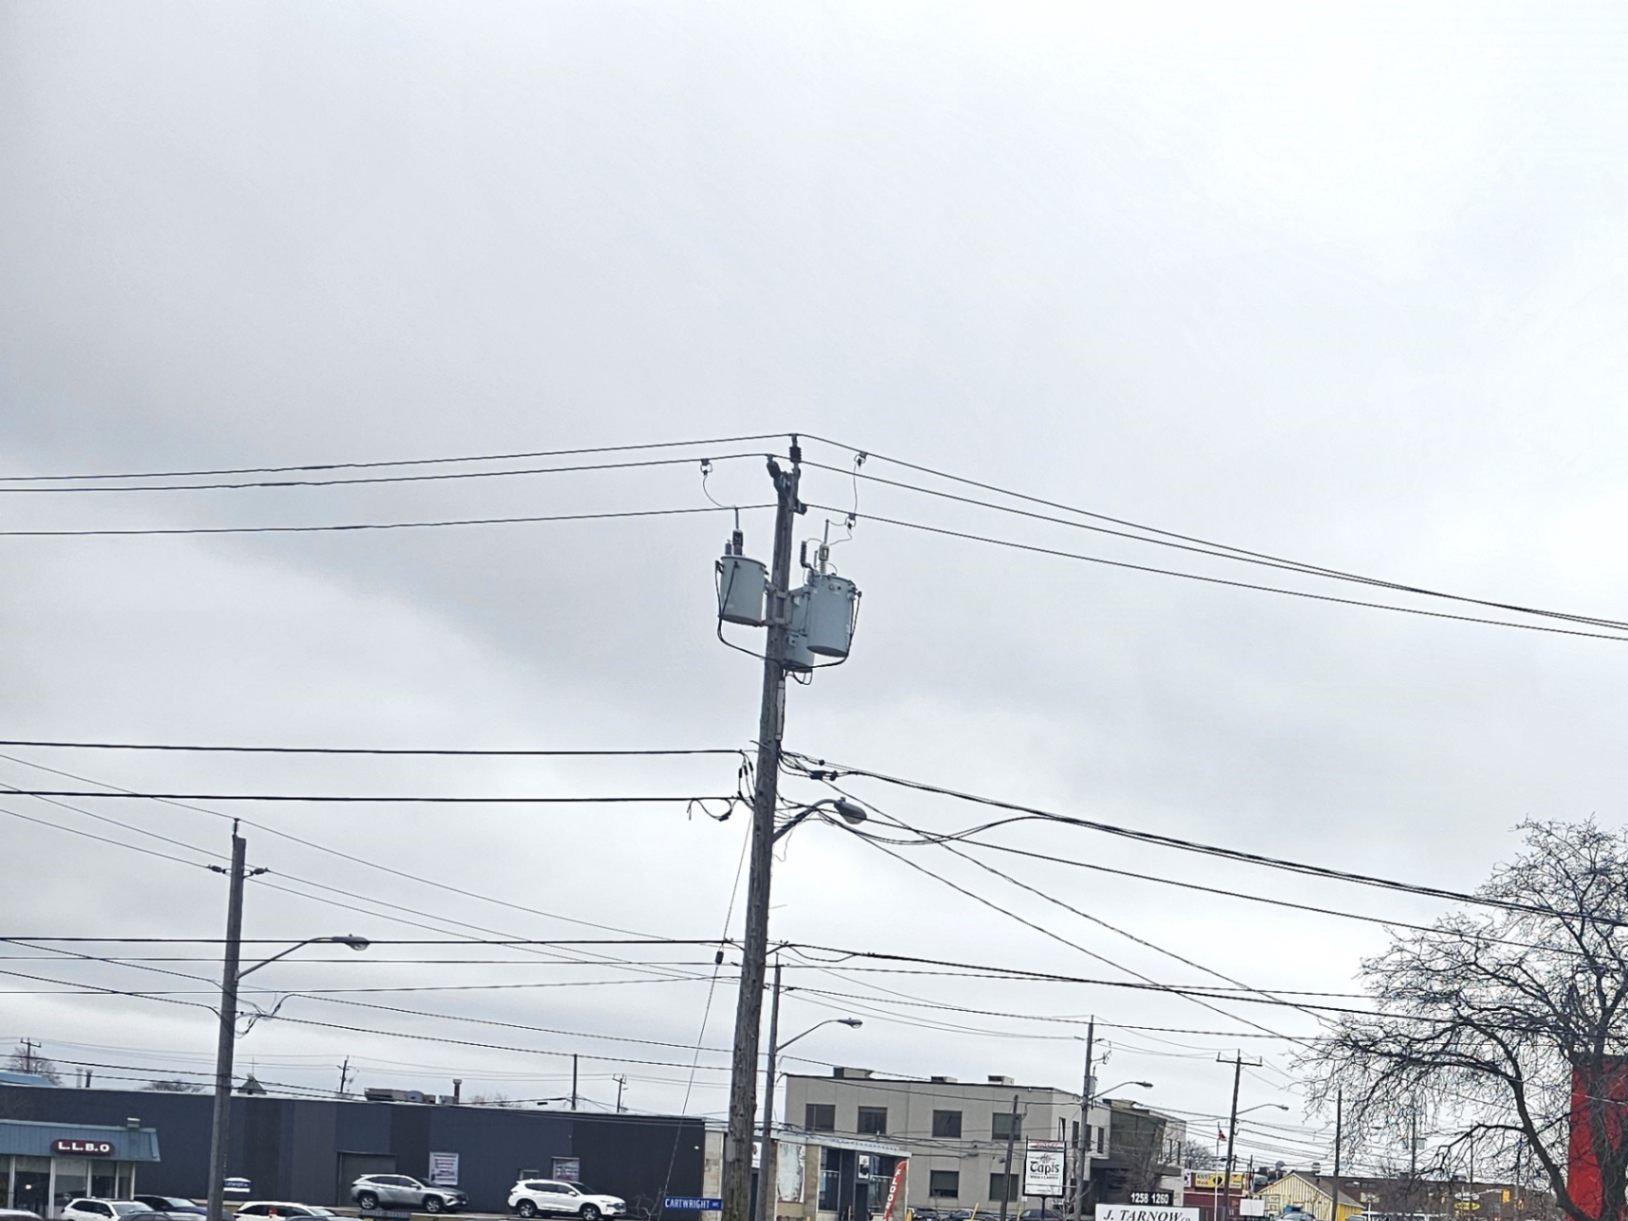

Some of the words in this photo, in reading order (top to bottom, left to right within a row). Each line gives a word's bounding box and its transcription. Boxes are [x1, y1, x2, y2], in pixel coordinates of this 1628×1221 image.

[664, 1198, 710, 1209] CARTWRIGHT
[1131, 1192, 1148, 1204] 1258
[1151, 1193, 1169, 1204] 1260
[1103, 1209, 1114, 1221] J.
